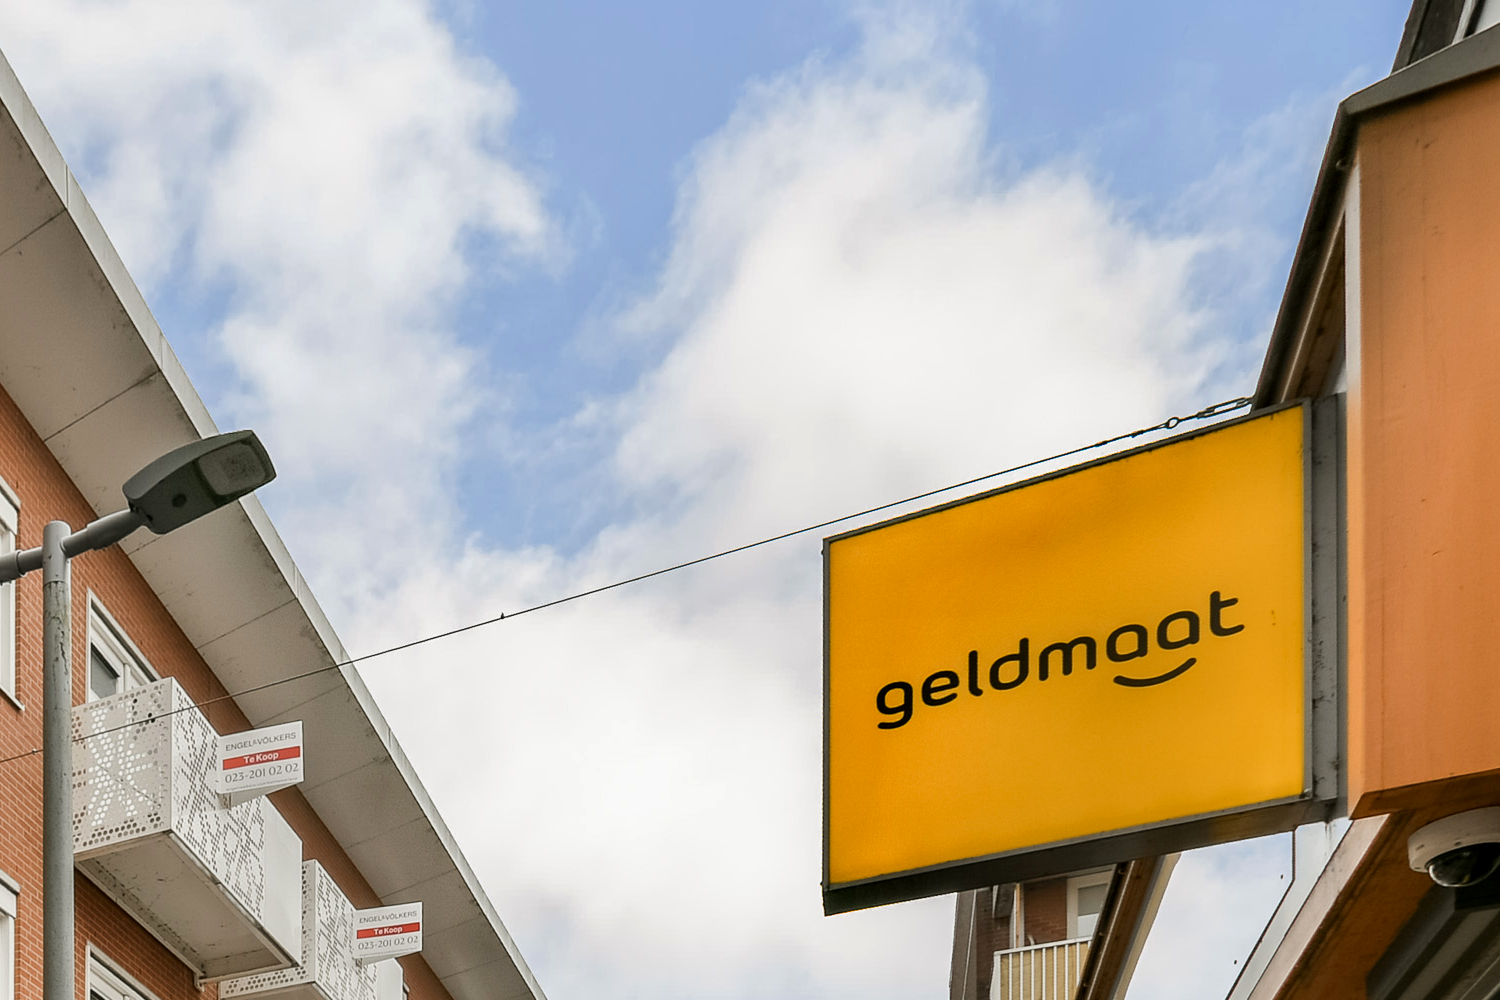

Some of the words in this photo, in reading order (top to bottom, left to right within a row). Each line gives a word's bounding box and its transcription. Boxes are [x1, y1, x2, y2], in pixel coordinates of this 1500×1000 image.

[876, 591, 1245, 729] geldmaat
[243, 756, 255, 764] Te
[255, 751, 279, 763] Koop
[225, 767, 267, 784] 023-201
[269, 765, 283, 776] 02
[285, 763, 299, 773] 02
[384, 926, 403, 935] Koop
[358, 939, 392, 950] 023-201
[394, 938, 405, 946] 02
[407, 935, 418, 944] 02
